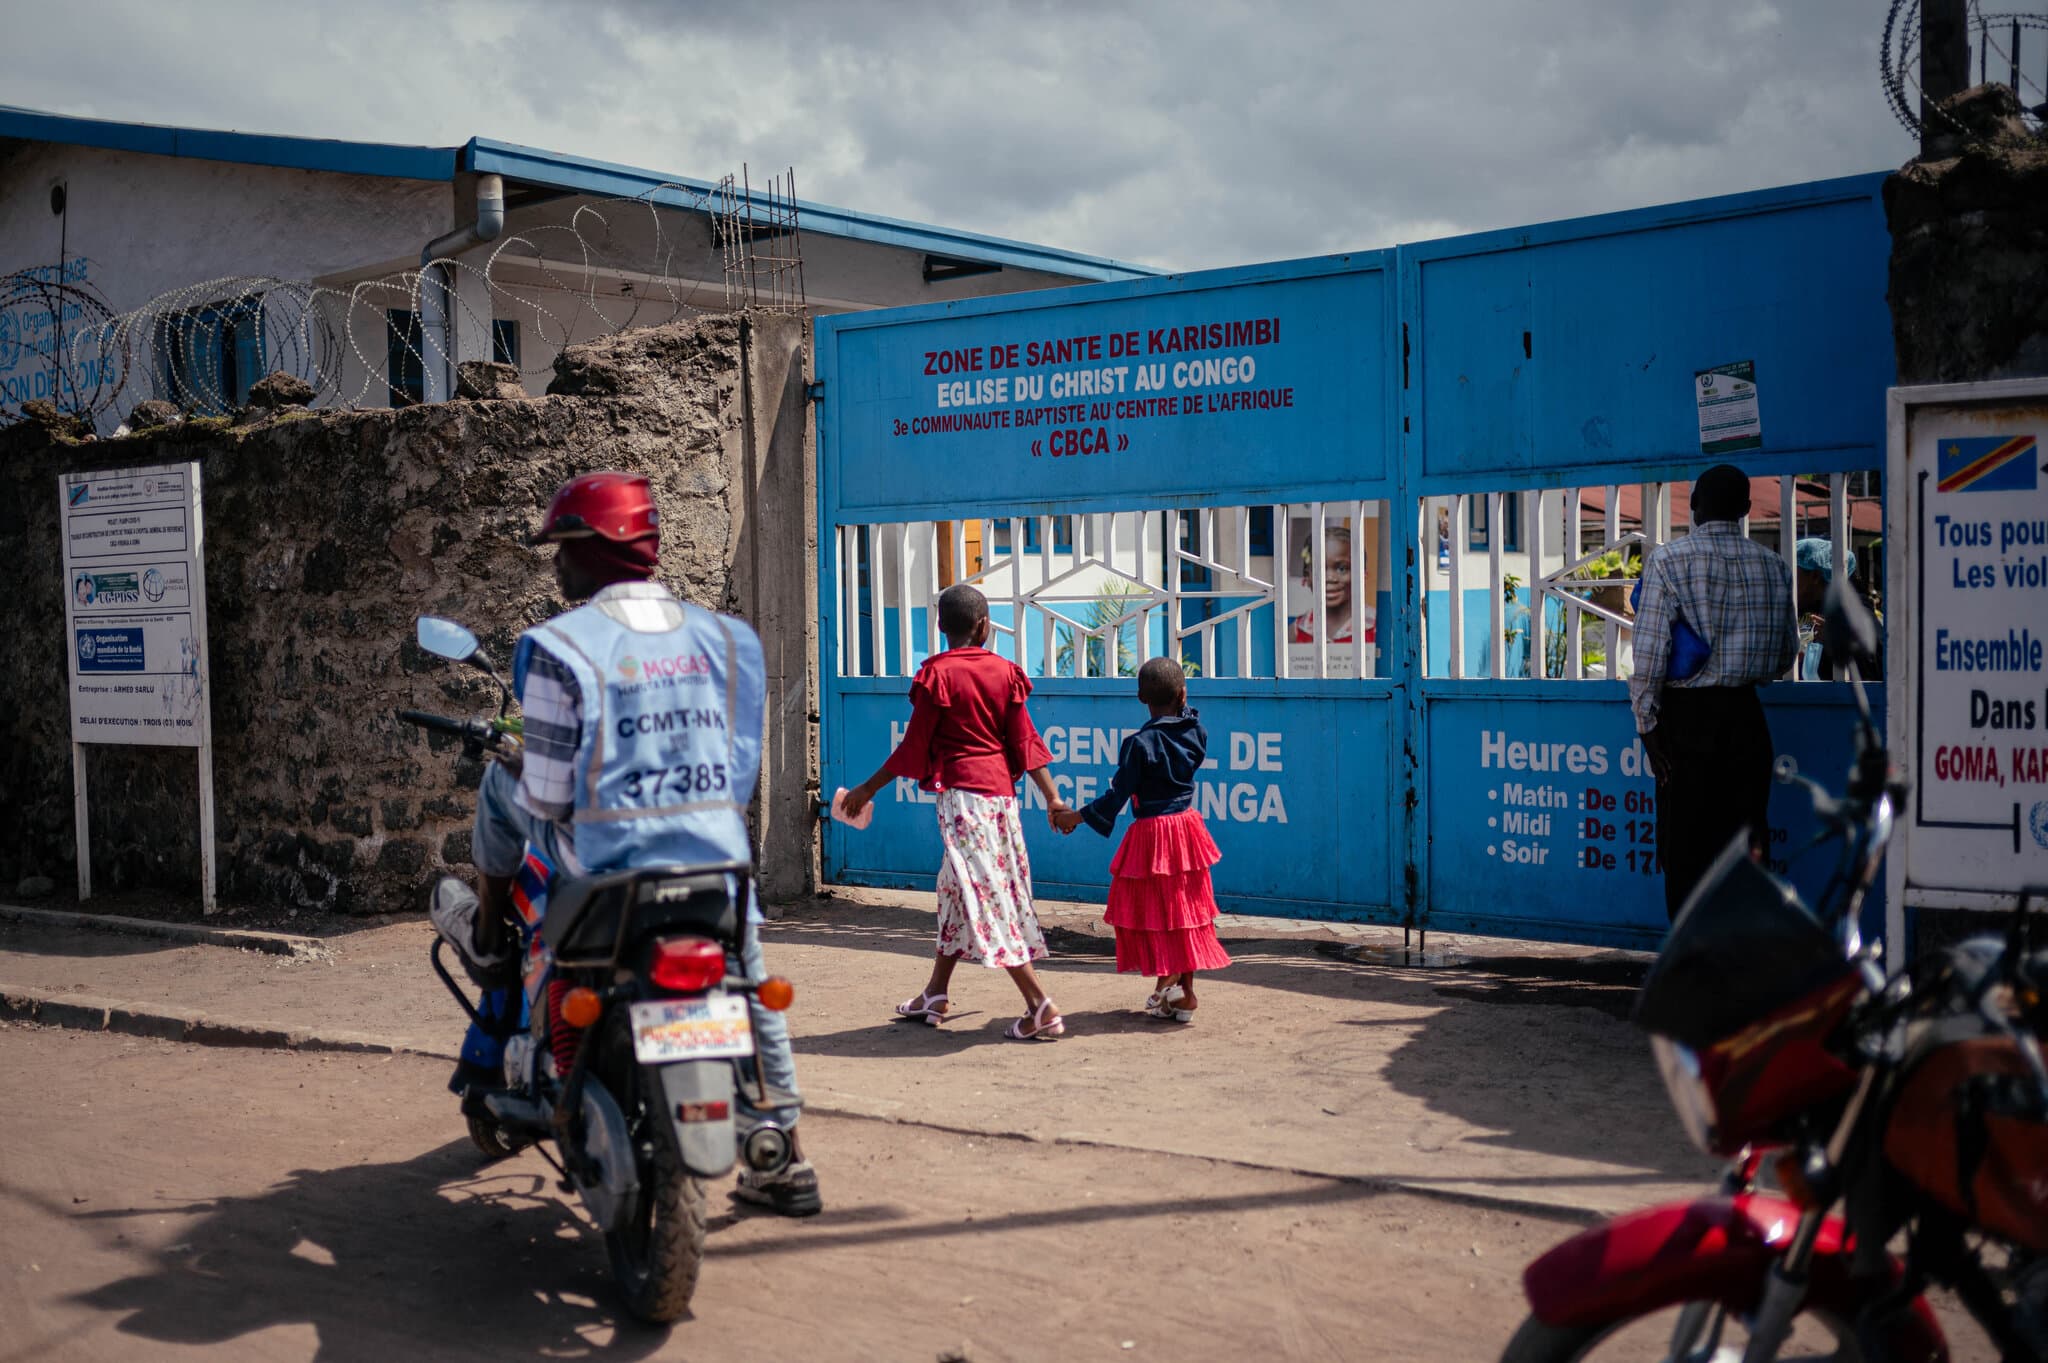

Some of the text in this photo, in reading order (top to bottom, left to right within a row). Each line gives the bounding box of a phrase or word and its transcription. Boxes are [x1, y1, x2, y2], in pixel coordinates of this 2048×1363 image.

[924, 318, 1280, 375] ZONE DE SANTE DE KARISIMBI
[938, 355, 1256, 408] EGLISE DU CHRIST AU CONGO
[893, 388, 1294, 436] 3e COMMUNAUTE BAPTISTE AU CENTRE DE L'AFRIQUE
[1049, 427, 1110, 457] CBCA
[1935, 515, 2048, 554] Tous pou
[1953, 557, 1996, 588] Les
[643, 655, 711, 680] MOGAS
[1936, 629, 2042, 671] Ensemble
[1971, 689, 2036, 729] Dans
[1230, 732, 1283, 771] DE
[1481, 730, 1609, 775] Heures
[1935, 745, 2005, 788] GOMA,
[1503, 782, 1568, 808] Matin
[1503, 811, 1551, 836] Midi
[1502, 839, 1549, 865] Soir
